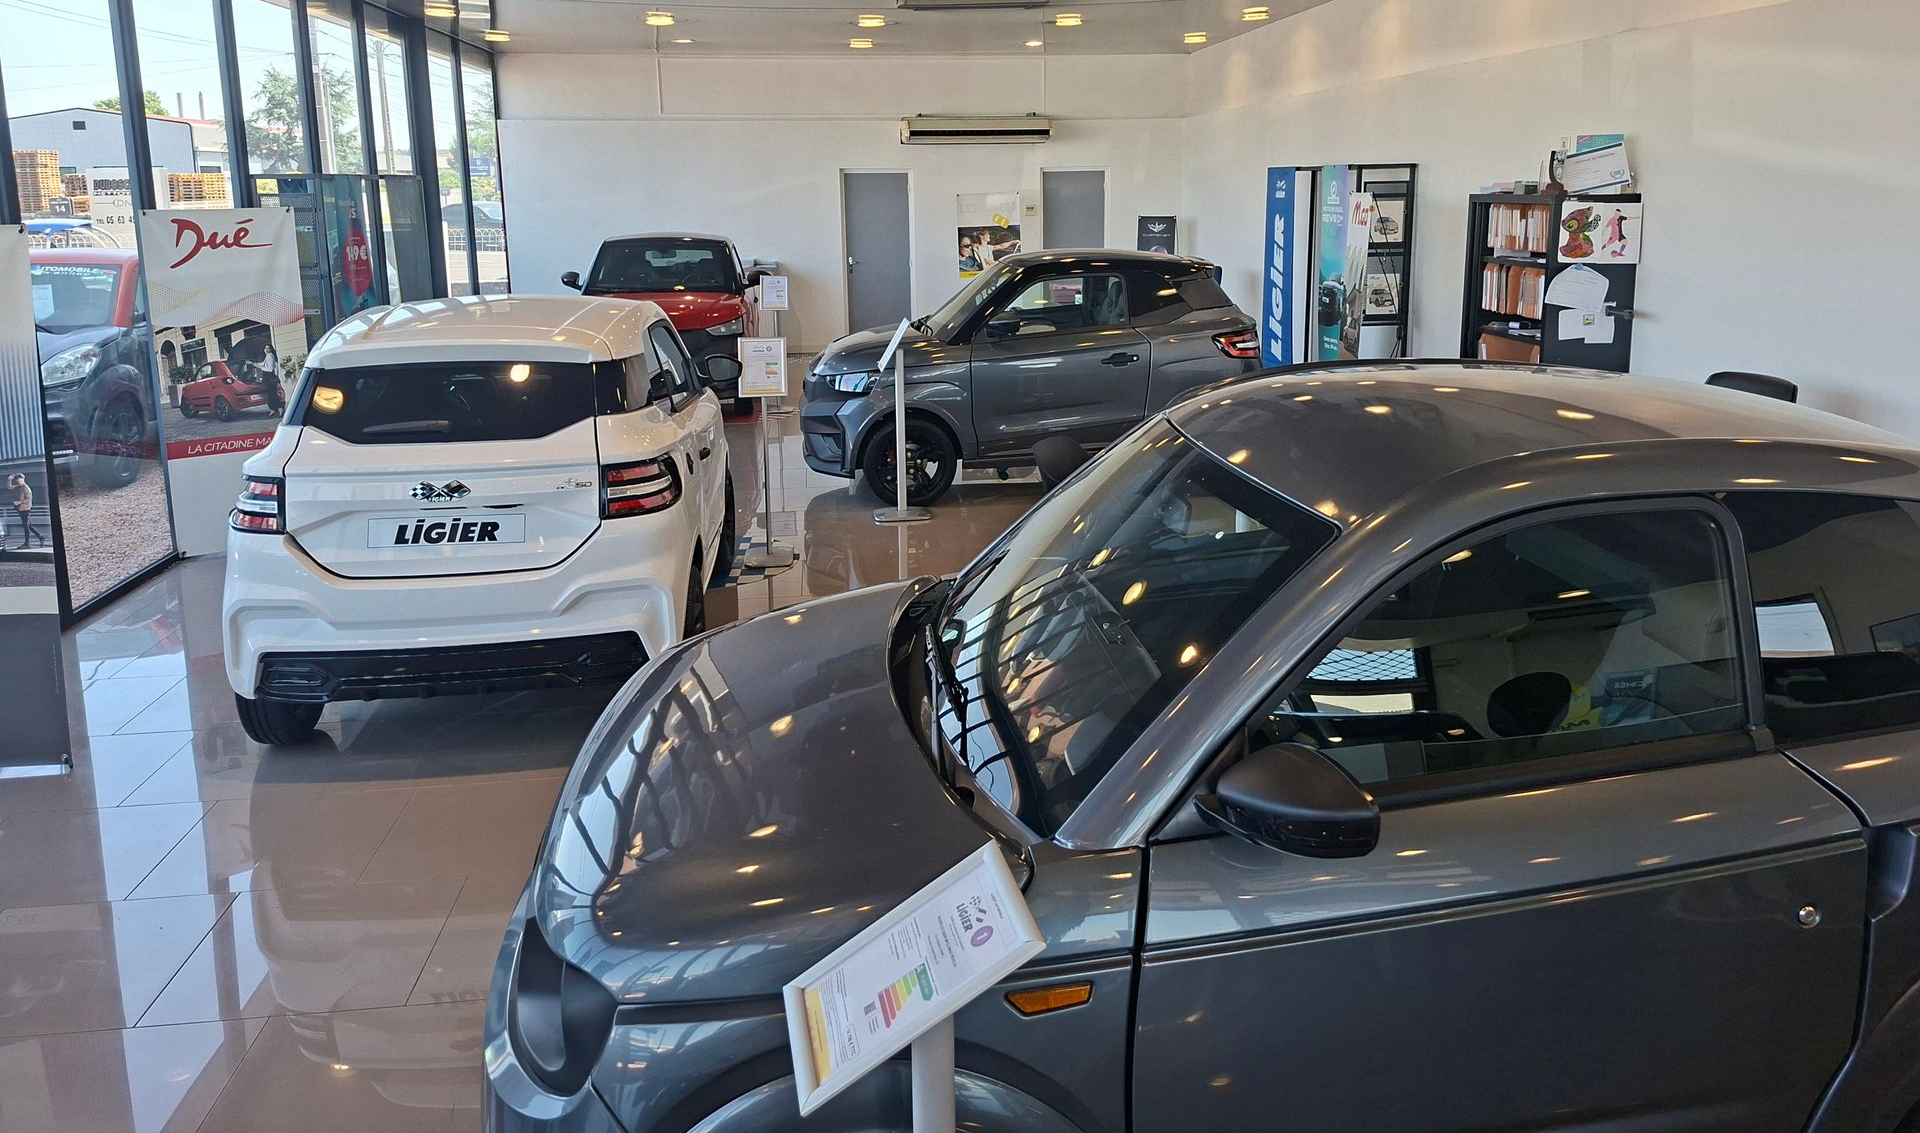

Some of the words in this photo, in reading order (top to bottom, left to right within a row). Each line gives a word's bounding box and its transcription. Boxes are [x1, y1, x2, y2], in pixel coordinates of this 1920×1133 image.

[106, 215, 114, 224] 05
[117, 215, 125, 225] 63
[170, 218, 273, 269] Dué
[36, 266, 99, 275] UTOMOBILE
[1268, 213, 1285, 362] LIGIER
[187, 445, 202, 455] LA
[204, 438, 254, 453] CITADINE
